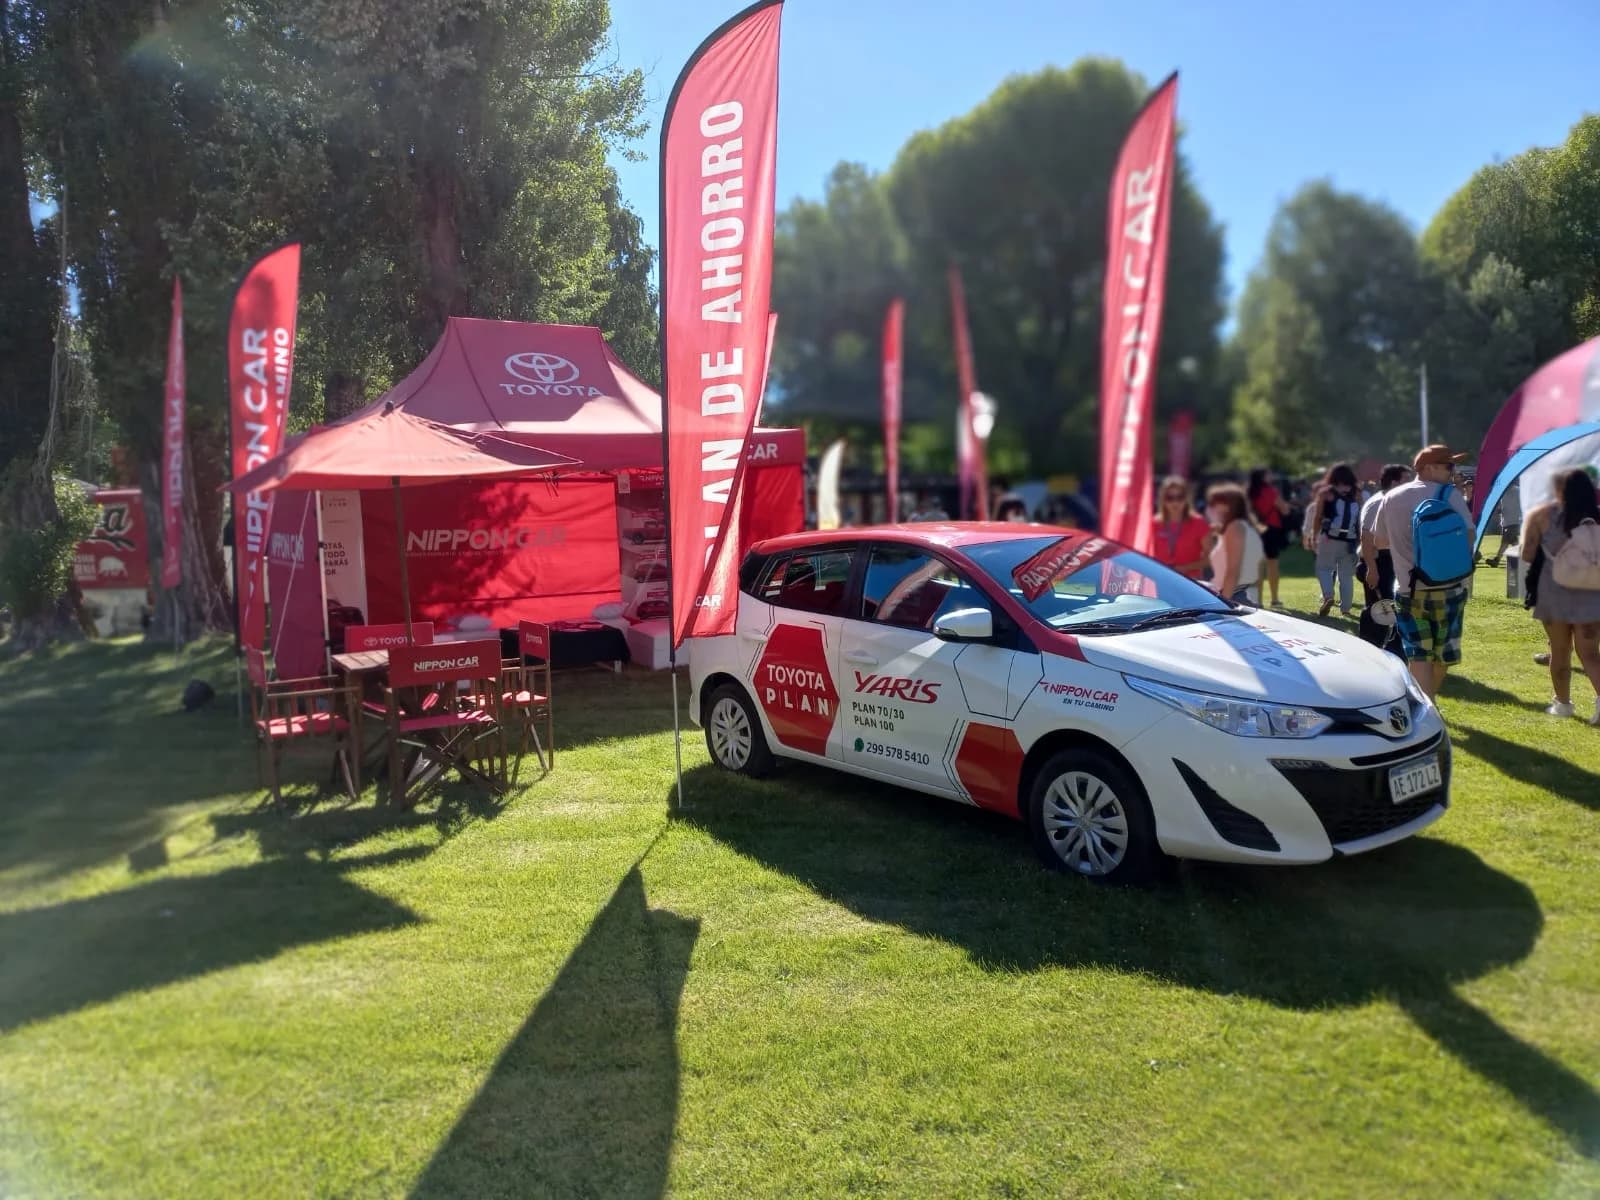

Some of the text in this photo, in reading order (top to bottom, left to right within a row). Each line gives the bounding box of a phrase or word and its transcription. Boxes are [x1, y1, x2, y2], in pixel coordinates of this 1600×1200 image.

[701, 100, 744, 323] AHORRO
[243, 328, 268, 413] CAR
[701, 347, 744, 416] DE
[499, 383, 604, 397] TOYOTA
[406, 527, 568, 551] NIPPON CAR
[414, 656, 479, 672] NIPPON CAR
[766, 664, 826, 691] TOYOTA
[1049, 683, 1119, 703] NIPPON CAR
[852, 701, 905, 720] PLAN 70/30
[1085, 701, 1115, 712] CAMINO
[854, 715, 895, 732] PLAN 100
[866, 742, 930, 765] 299 578 5410
[1393, 764, 1439, 799] AE 172 LZ
